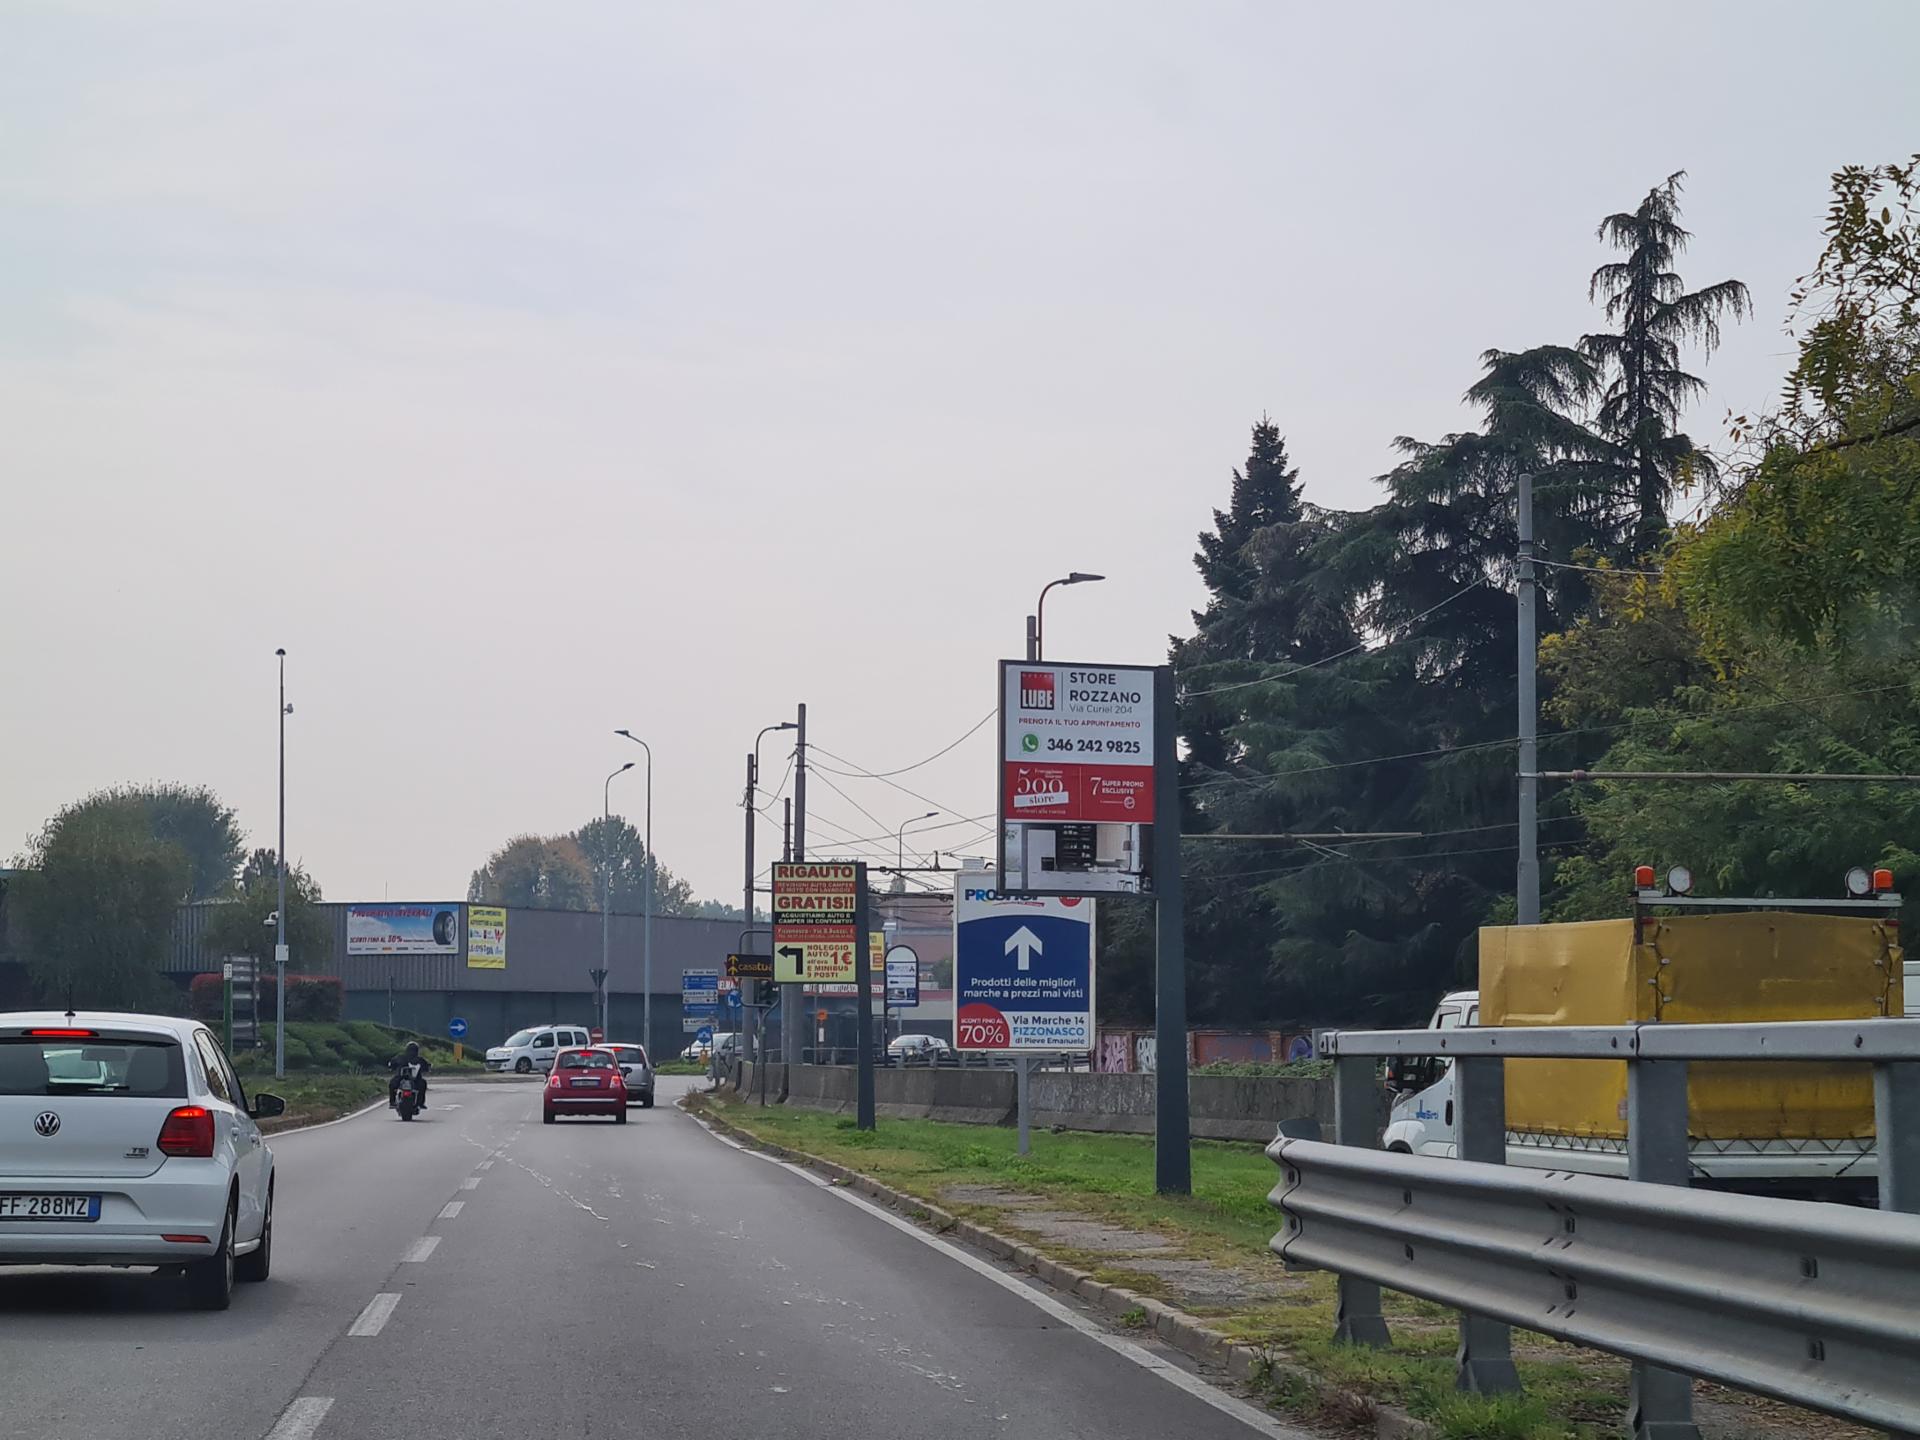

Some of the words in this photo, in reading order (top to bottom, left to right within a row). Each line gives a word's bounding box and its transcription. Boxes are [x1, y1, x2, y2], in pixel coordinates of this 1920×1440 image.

[1070, 672, 1117, 685] STORE
[1022, 689, 1053, 708] LUBE
[1069, 690, 1141, 704] ROZZANO
[1069, 703, 1084, 713] Via
[1086, 704, 1113, 714] Curiel
[1114, 705, 1133, 714] 204
[1018, 718, 1053, 726] PRENOTA
[1063, 719, 1080, 727] TUO
[1081, 720, 1141, 729] APPUNTAMENTO
[1047, 738, 1073, 751] 346
[1077, 739, 1103, 752] 242
[1106, 741, 1140, 753] 9825
[1017, 768, 1063, 794] 500
[1090, 777, 1102, 795] 7
[1101, 787, 1135, 795] ESCLUSIVE
[1028, 794, 1055, 805] store
[777, 866, 853, 878] RIGAUTO
[777, 896, 854, 909] GRATIS!!
[830, 952, 853, 965] 1€
[971, 978, 1011, 987] Prodotti
[1013, 978, 1037, 987] delle
[1039, 978, 1076, 989] migliori
[964, 989, 1000, 998] marche
[1011, 989, 1040, 999] prezzi
[1042, 989, 1061, 998] mai
[1063, 989, 1083, 998] visti
[1012, 1016, 1029, 1025] Via
[1031, 1016, 1072, 1025] Marche
[1074, 1016, 1084, 1025] 14
[960, 1025, 1004, 1043] 70%
[1013, 1026, 1085, 1036] FIZZONASCO
